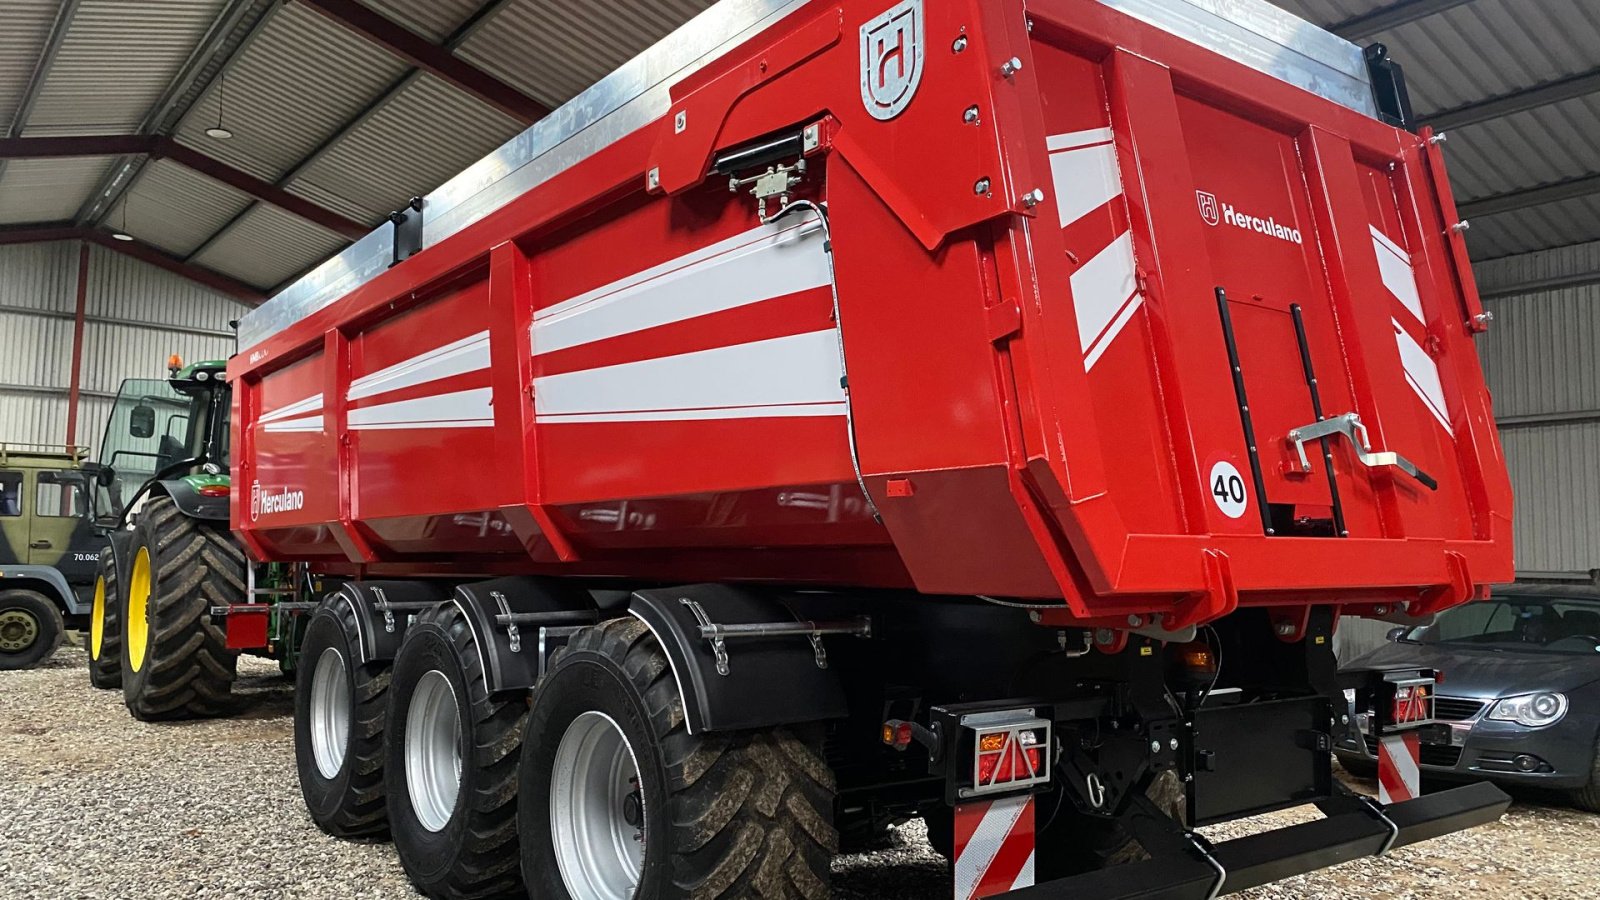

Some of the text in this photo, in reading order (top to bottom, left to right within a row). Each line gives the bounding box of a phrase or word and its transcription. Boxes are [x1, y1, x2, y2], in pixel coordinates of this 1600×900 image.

[1222, 203, 1302, 244] Herculano
[261, 486, 303, 514] Herculano
[1214, 475, 1244, 503] 40
[73, 553, 99, 561] 70.062
